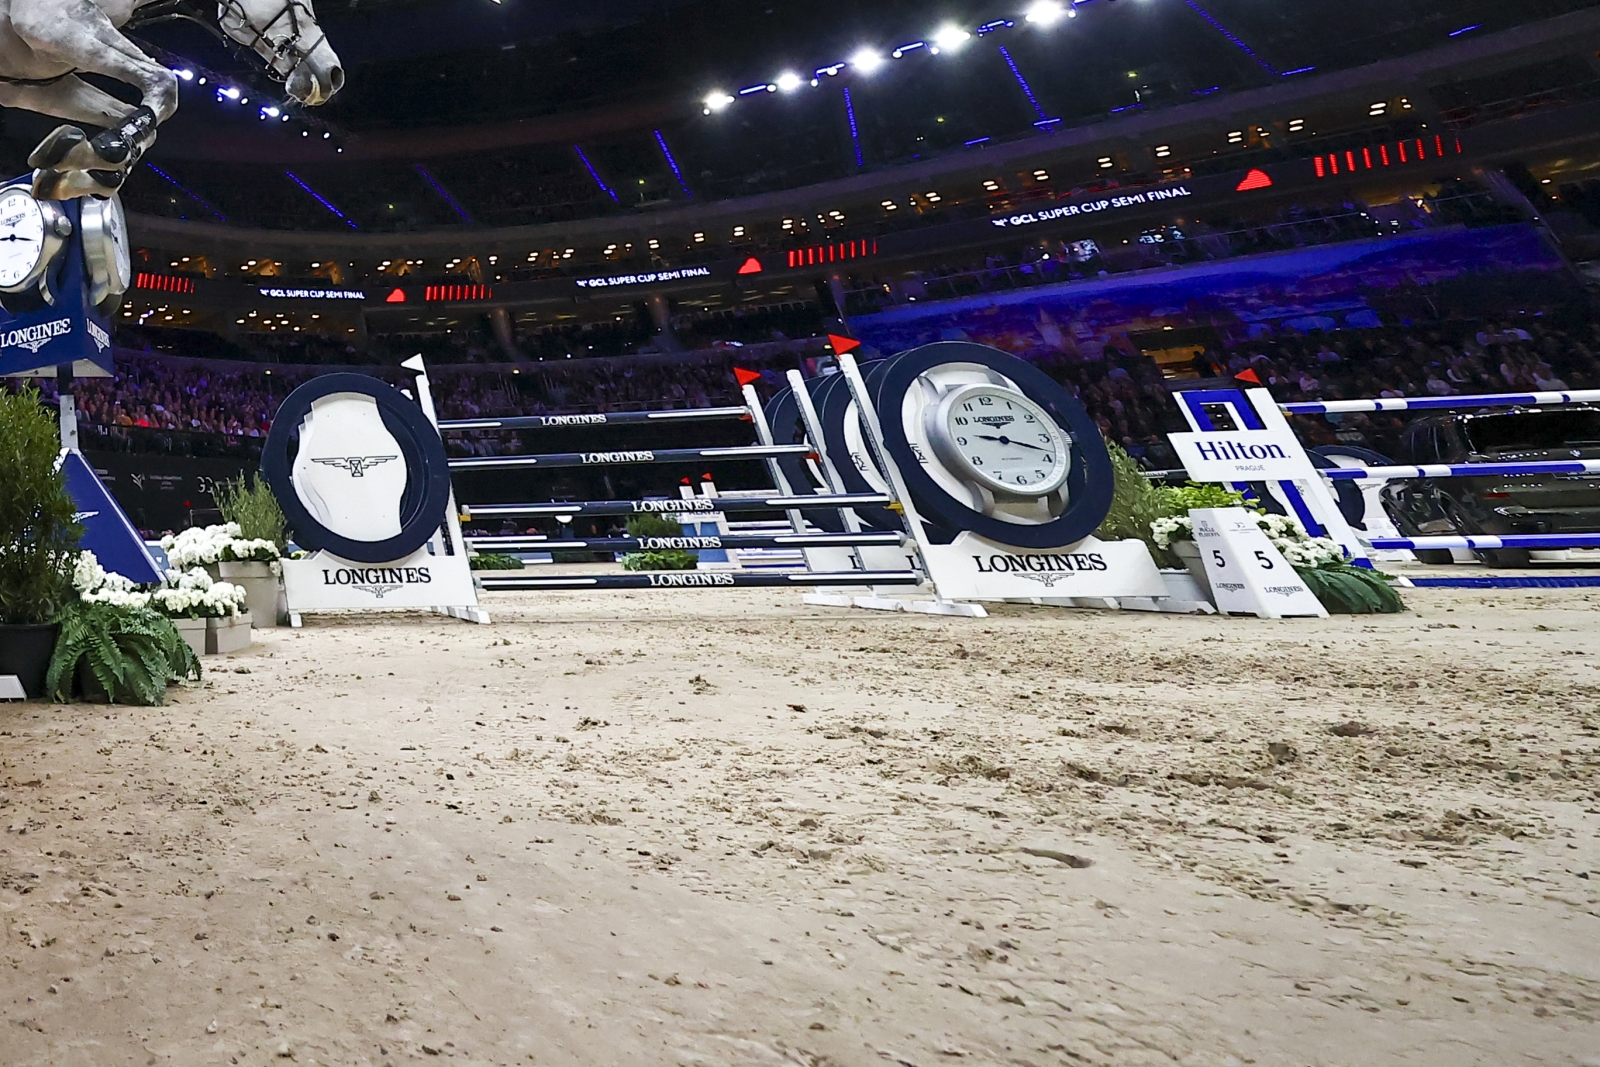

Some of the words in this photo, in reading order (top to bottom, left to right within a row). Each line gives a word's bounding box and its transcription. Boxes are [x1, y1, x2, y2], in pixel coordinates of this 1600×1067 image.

[1010, 214, 1038, 226] GCL
[1038, 205, 1080, 221] SUPER
[1080, 200, 1110, 213] CUP
[1110, 194, 1146, 208] SEMI
[1147, 186, 1191, 201] FINAL
[588, 278, 608, 287] GCL
[608, 275, 637, 286] SUPER
[637, 273, 657, 283] CUP
[657, 270, 680, 281] SEMI
[681, 267, 710, 278] FINAL
[286, 289, 309, 298] SUPER
[309, 290, 325, 298] CUP
[325, 290, 343, 298] SEMI
[344, 291, 365, 300] FINAL
[0, 318, 71, 348] LONGINES
[978, 396, 993, 406] 12
[962, 403, 973, 412] 11
[540, 414, 607, 426] LONGINES
[955, 417, 968, 426] 10
[973, 415, 1015, 423] LONGINES
[1024, 414, 1035, 424] 2
[956, 437, 968, 446] 9
[1038, 434, 1050, 443] 3
[580, 451, 655, 464] LONGINES
[971, 456, 983, 466] 8
[1042, 454, 1053, 464] 4
[993, 471, 1003, 480] 7
[1034, 470, 1046, 479] 5
[1016, 475, 1028, 485] 6
[631, 499, 714, 512] LONGINES
[637, 536, 722, 549] LONGINES
[972, 553, 1108, 573] LONGINES
[1212, 550, 1226, 568] 5
[1254, 551, 1274, 569] 5
[324, 567, 431, 585] LONGINES
[648, 573, 735, 586] LONGINES
[1263, 586, 1304, 594] LONGINES
